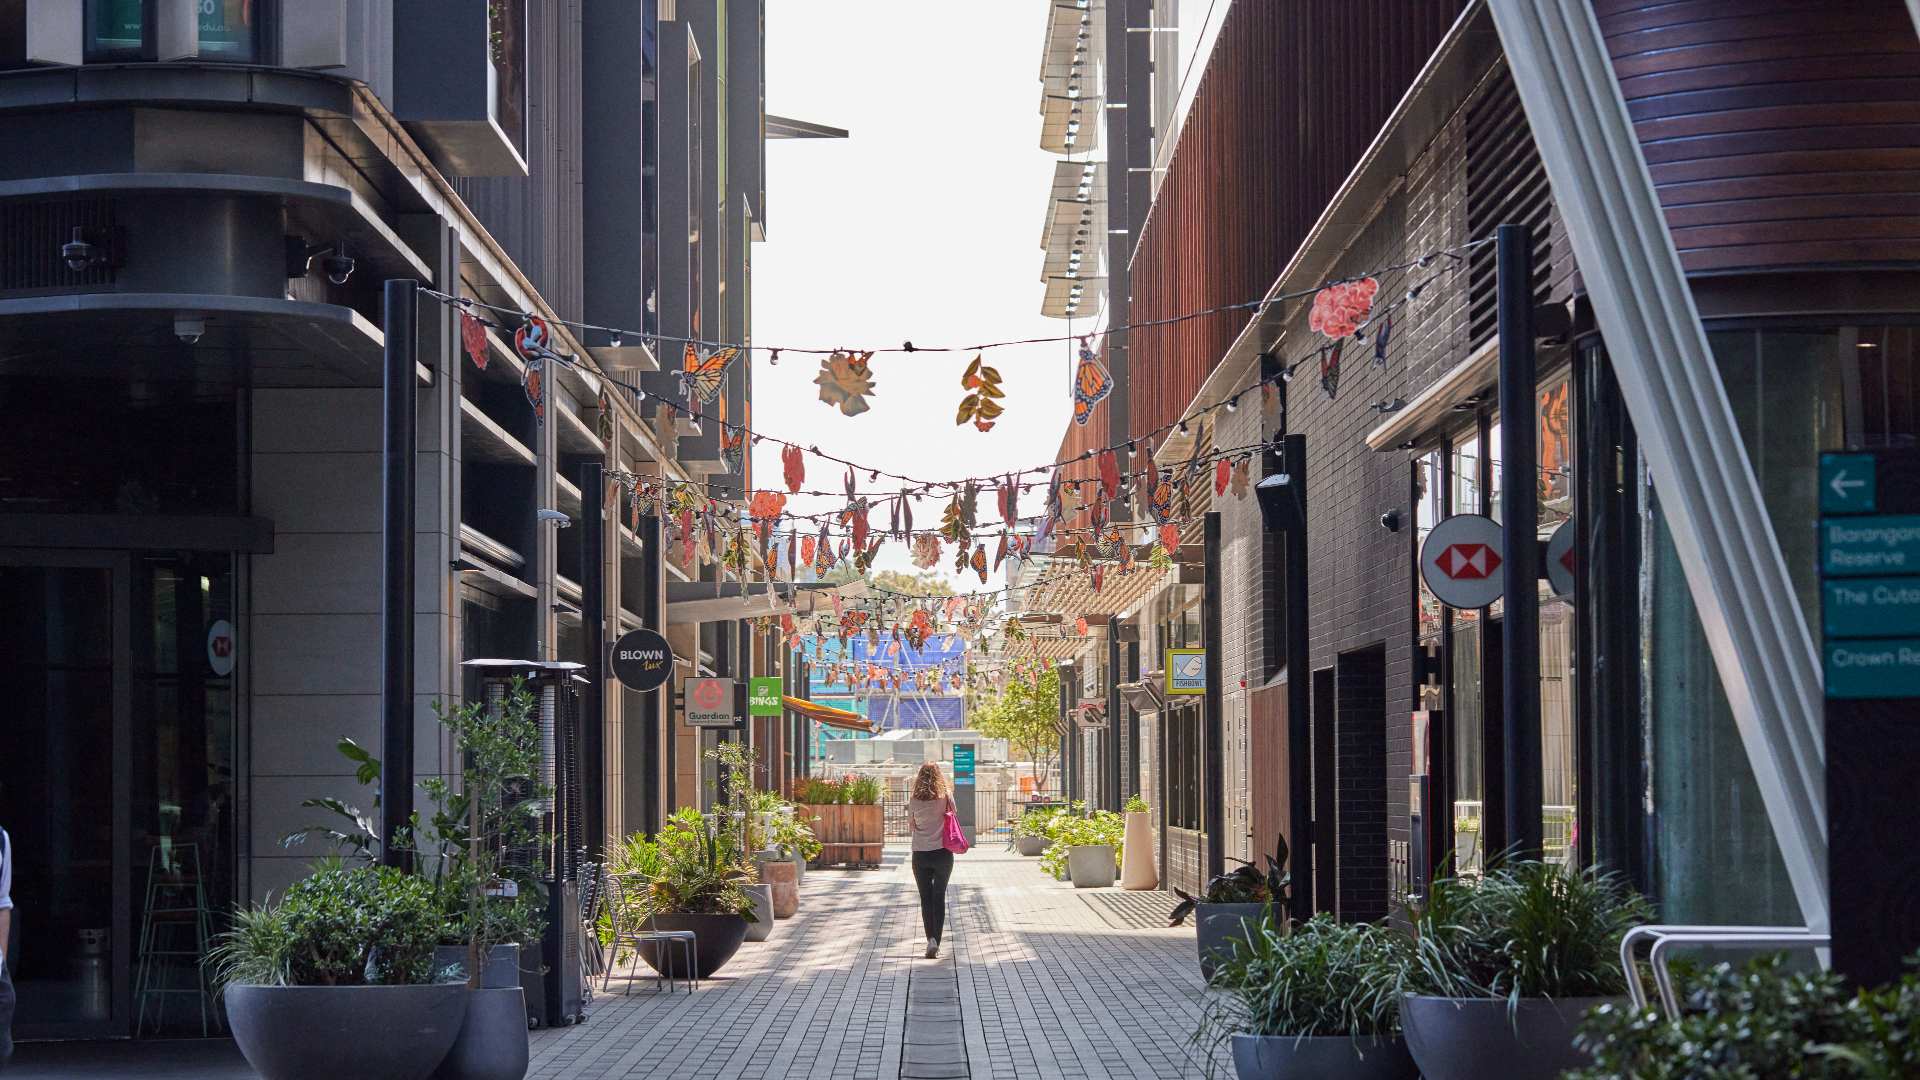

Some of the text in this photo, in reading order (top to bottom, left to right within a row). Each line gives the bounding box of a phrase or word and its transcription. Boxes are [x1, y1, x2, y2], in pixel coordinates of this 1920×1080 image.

[1829, 548, 1905, 566] Reserve
[1834, 587, 1868, 605] The
[620, 650, 664, 660] BLOWN
[1832, 648, 1896, 668] Crown
[688, 711, 730, 720] Guardian
